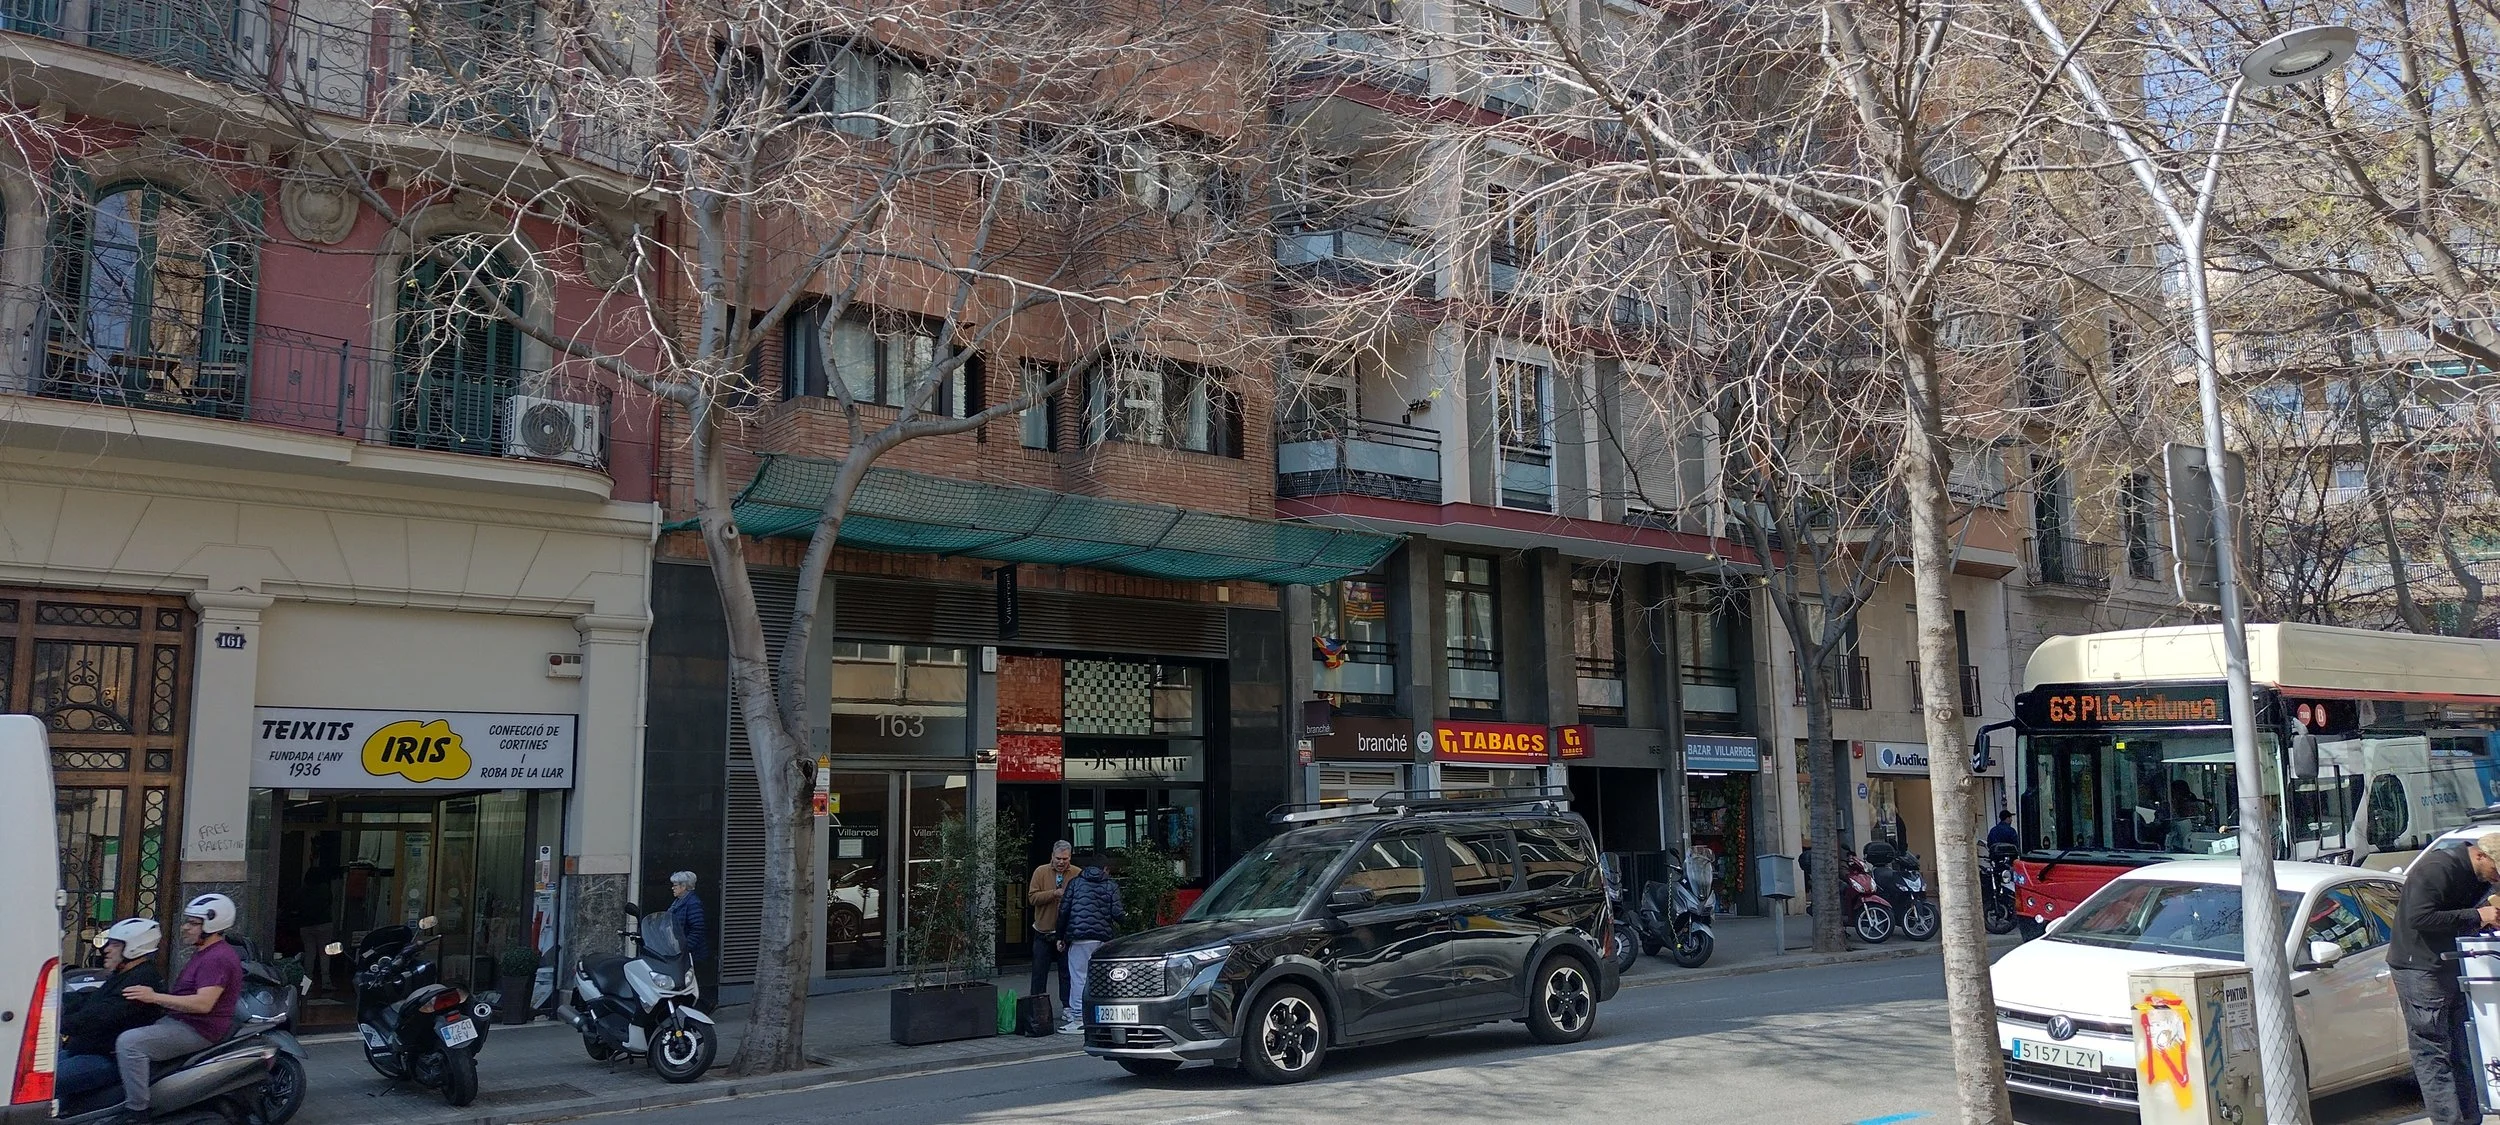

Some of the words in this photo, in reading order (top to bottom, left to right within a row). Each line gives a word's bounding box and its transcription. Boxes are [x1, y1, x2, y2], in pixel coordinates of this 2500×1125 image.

[220, 635, 242, 648] 161
[2050, 696, 2077, 722] 63
[262, 720, 354, 741] TEIXITS
[489, 723, 544, 736] CONFECCIÓ
[546, 726, 560, 737] DE
[875, 711, 925, 738] 163
[1306, 724, 1330, 734] branché
[500, 739, 549, 751] CORTINES
[1358, 732, 1408, 752] branché
[1460, 731, 1545, 752] TABACS
[269, 750, 314, 762] FUNDADA
[317, 751, 344, 762] L'ANY
[381, 736, 451, 765] IRIS
[1687, 744, 1712, 756] BAZAR
[1714, 745, 1756, 758] VILLARROEL
[1894, 752, 1929, 767] Audika
[289, 763, 321, 778] 1936
[480, 767, 507, 778] ROBA
[511, 768, 525, 778] DE
[526, 768, 538, 778] LA
[541, 768, 564, 779] LLAR
[199, 822, 230, 840] FREE
[837, 828, 879, 837] Villarroel
[2225, 986, 2248, 1002] PINTOR
[1100, 1007, 1119, 1021] 2921
[1121, 1007, 1137, 1021] NGH
[449, 1020, 472, 1036] 7240
[452, 1030, 470, 1043] HFV
[2023, 1043, 2060, 1063] 5157
[2066, 1050, 2096, 1069] LZY
